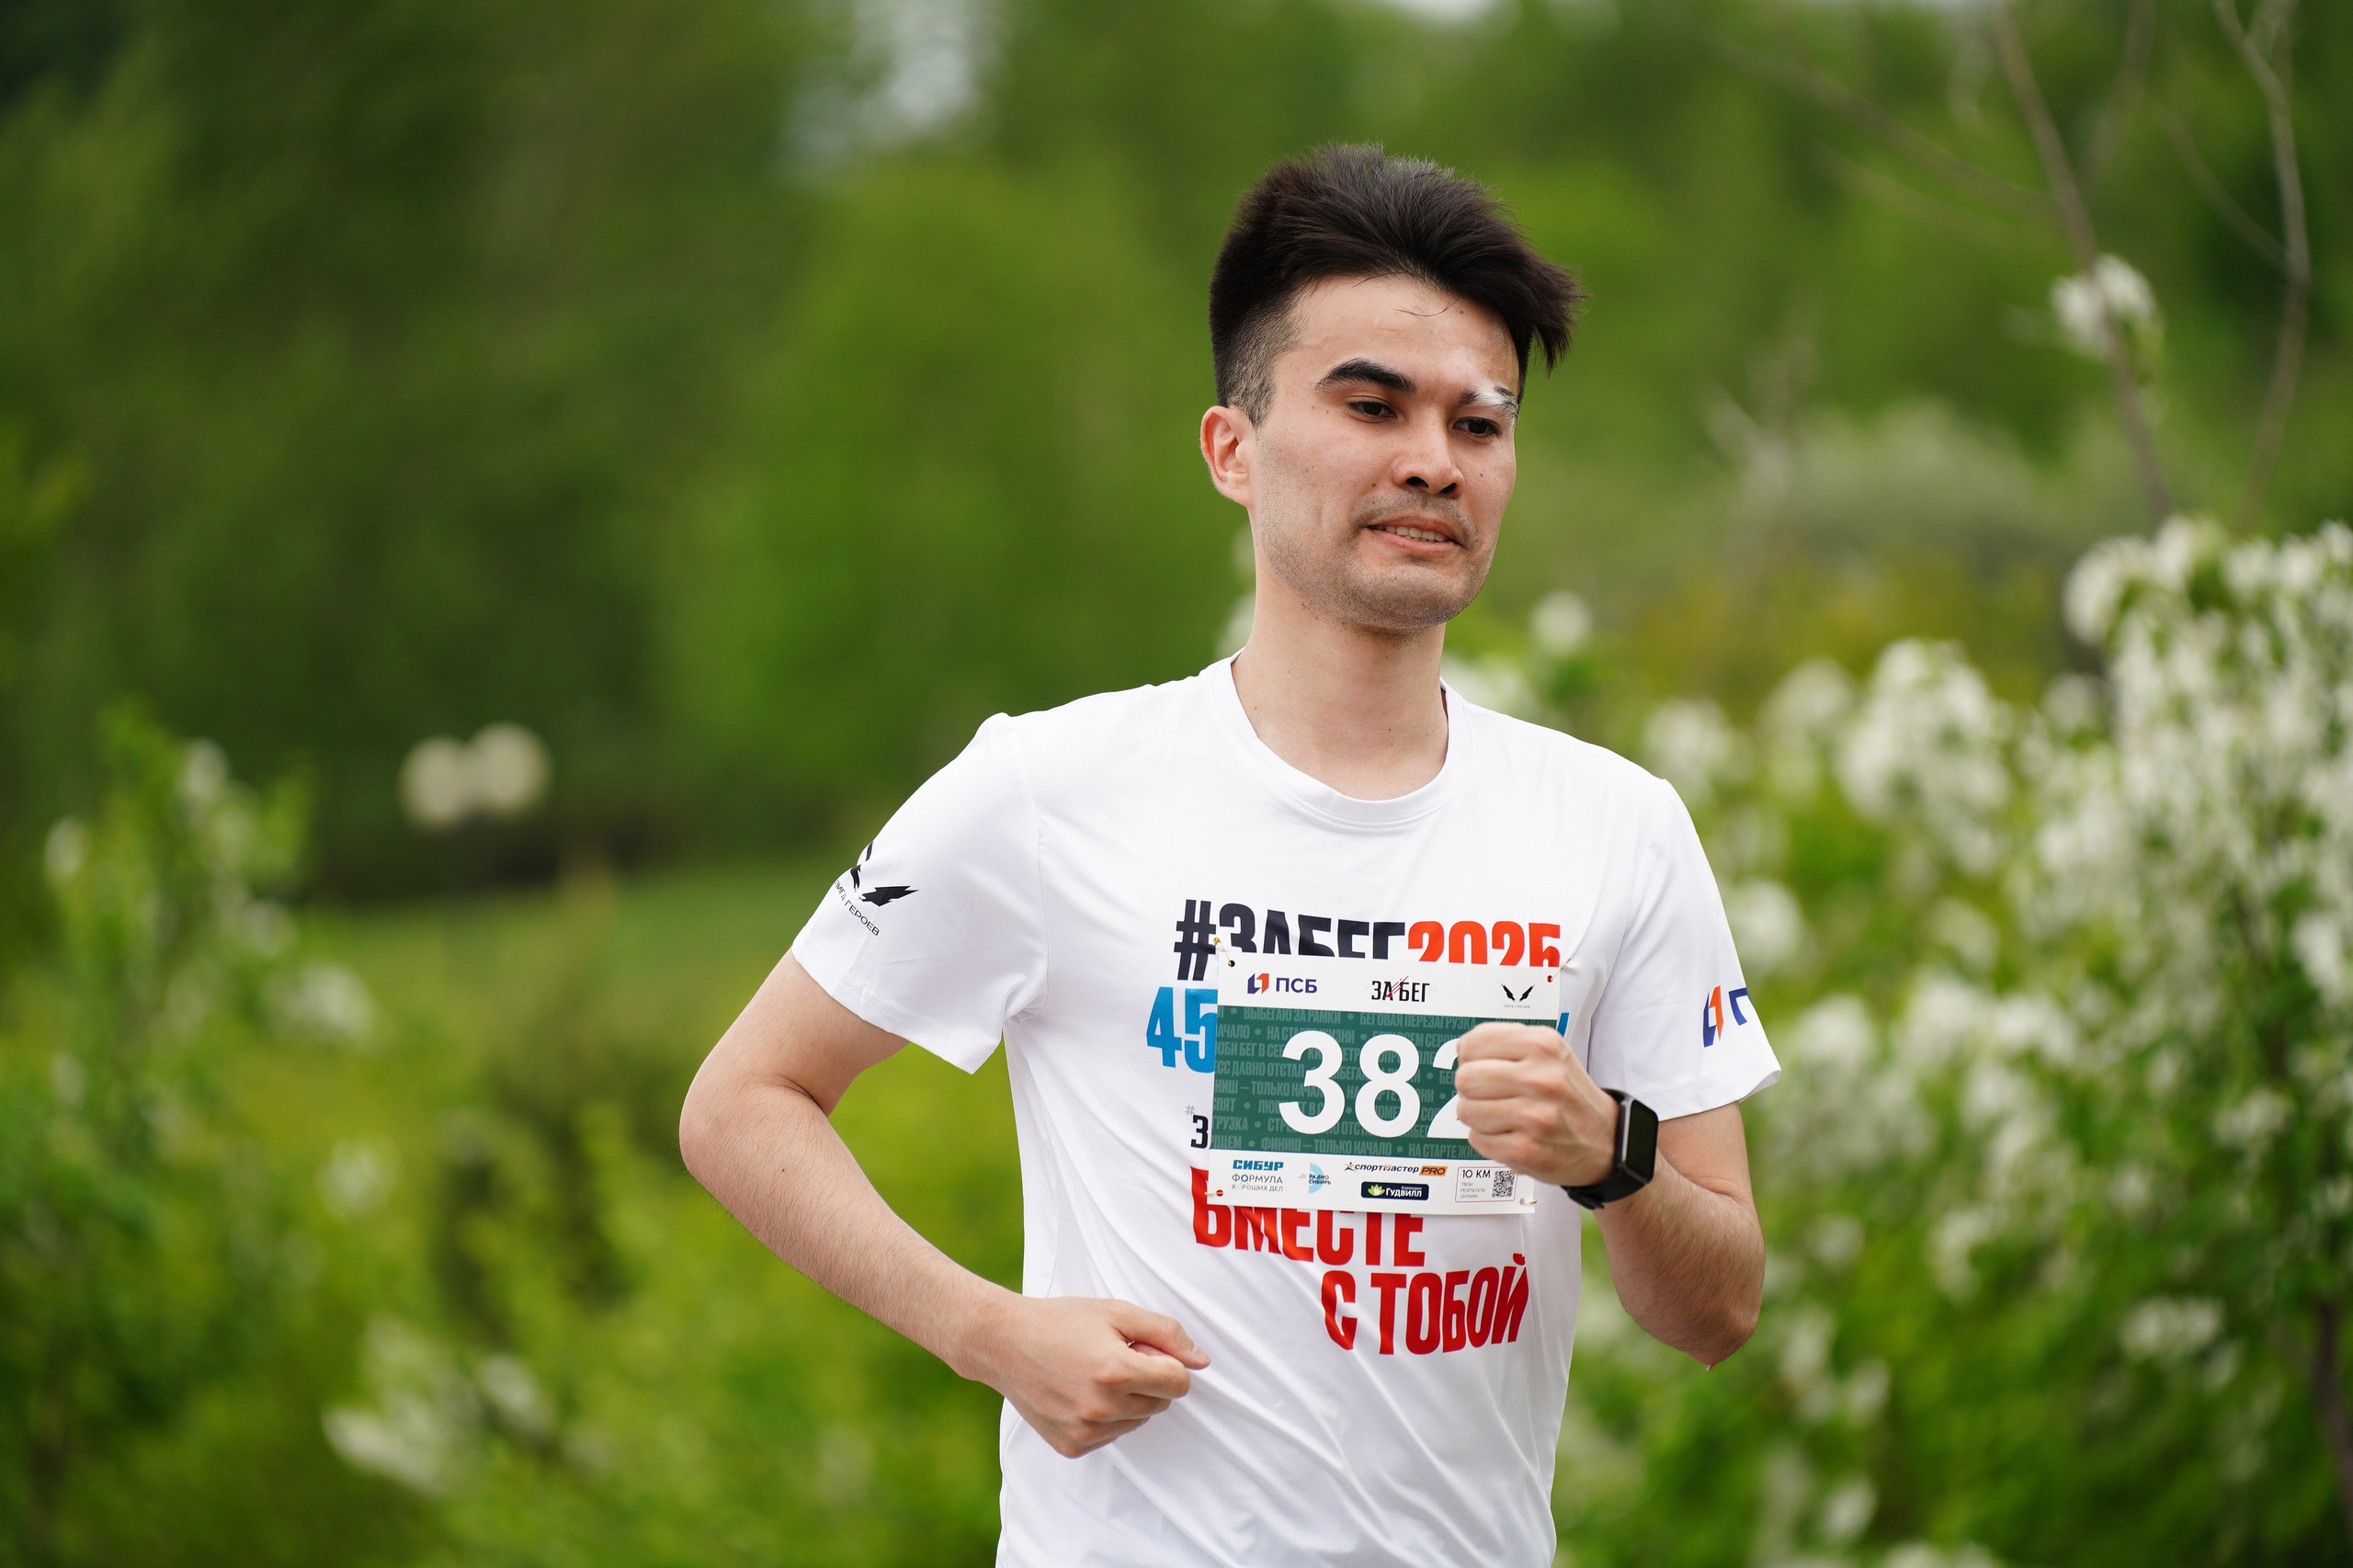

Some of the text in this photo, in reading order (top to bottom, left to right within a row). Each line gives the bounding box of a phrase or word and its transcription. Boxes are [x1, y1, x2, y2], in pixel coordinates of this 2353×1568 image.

[834, 880, 881, 937] ЛИГА ГЕРОЕВ
[1276, 977, 1318, 994] ПСБ
[1146, 986, 1219, 1074] 45
[1216, 1024, 1250, 1039] АЧАЛО
[1232, 1061, 1267, 1076] ДАВНО
[1267, 1062, 1305, 1078] ОТСТАЛ
[1251, 1081, 1290, 1096] ТОЛЬКО
[1291, 1083, 1324, 1098] НАЧАЛ
[1261, 1137, 1302, 1153] ФИНИШ
[1313, 1139, 1352, 1154] ТОЛЬКО
[1354, 1140, 1392, 1156] НАЧАЛО
[1233, 1160, 1284, 1172] СИБУР
[1421, 1167, 1447, 1176] PRO
[1462, 1169, 1472, 1178] 10
[1232, 1174, 1283, 1184] ФОРМУЛА
[1385, 1187, 1422, 1198] Гудвилл
[1321, 1253, 1529, 1355] С ТОБОЙ
